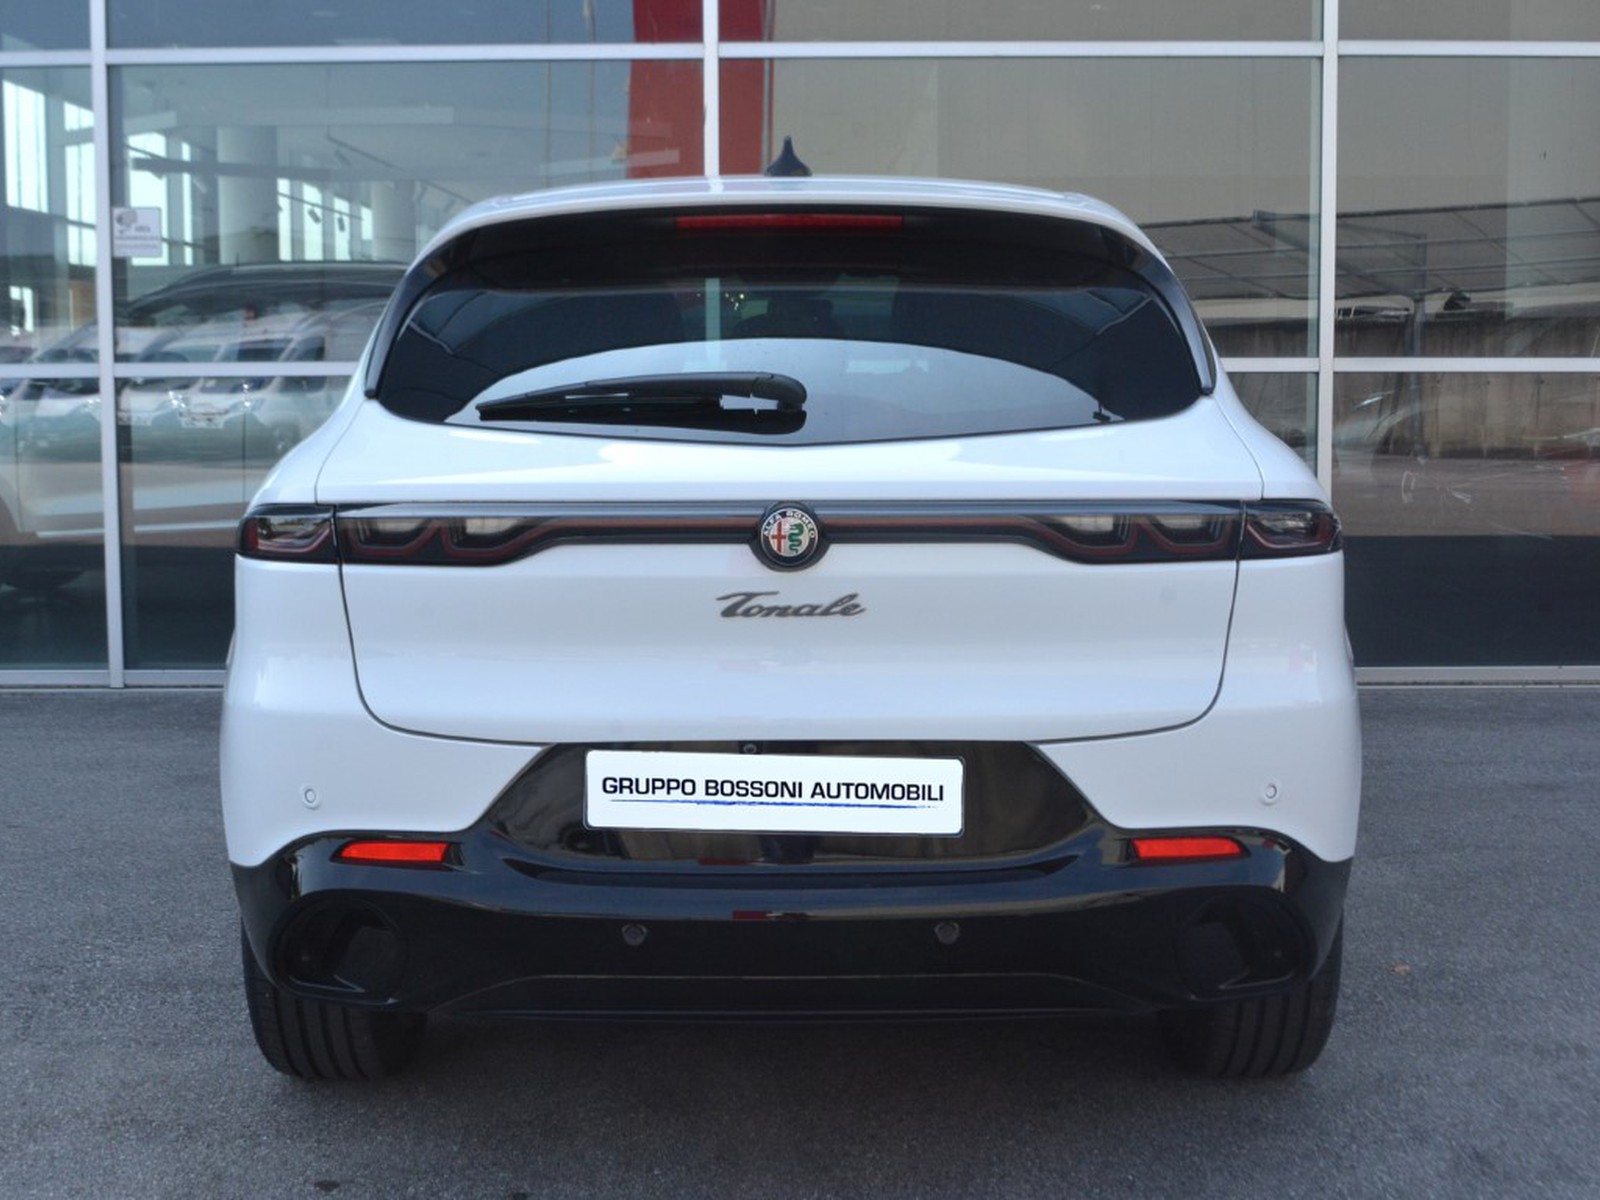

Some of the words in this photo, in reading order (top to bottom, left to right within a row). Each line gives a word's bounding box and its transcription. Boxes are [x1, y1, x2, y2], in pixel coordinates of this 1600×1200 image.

[715, 591, 866, 618] Tonale
[602, 777, 696, 796] GRUPPO
[704, 779, 803, 799] BOSSONI
[811, 782, 944, 801] AUTOMOBILI
